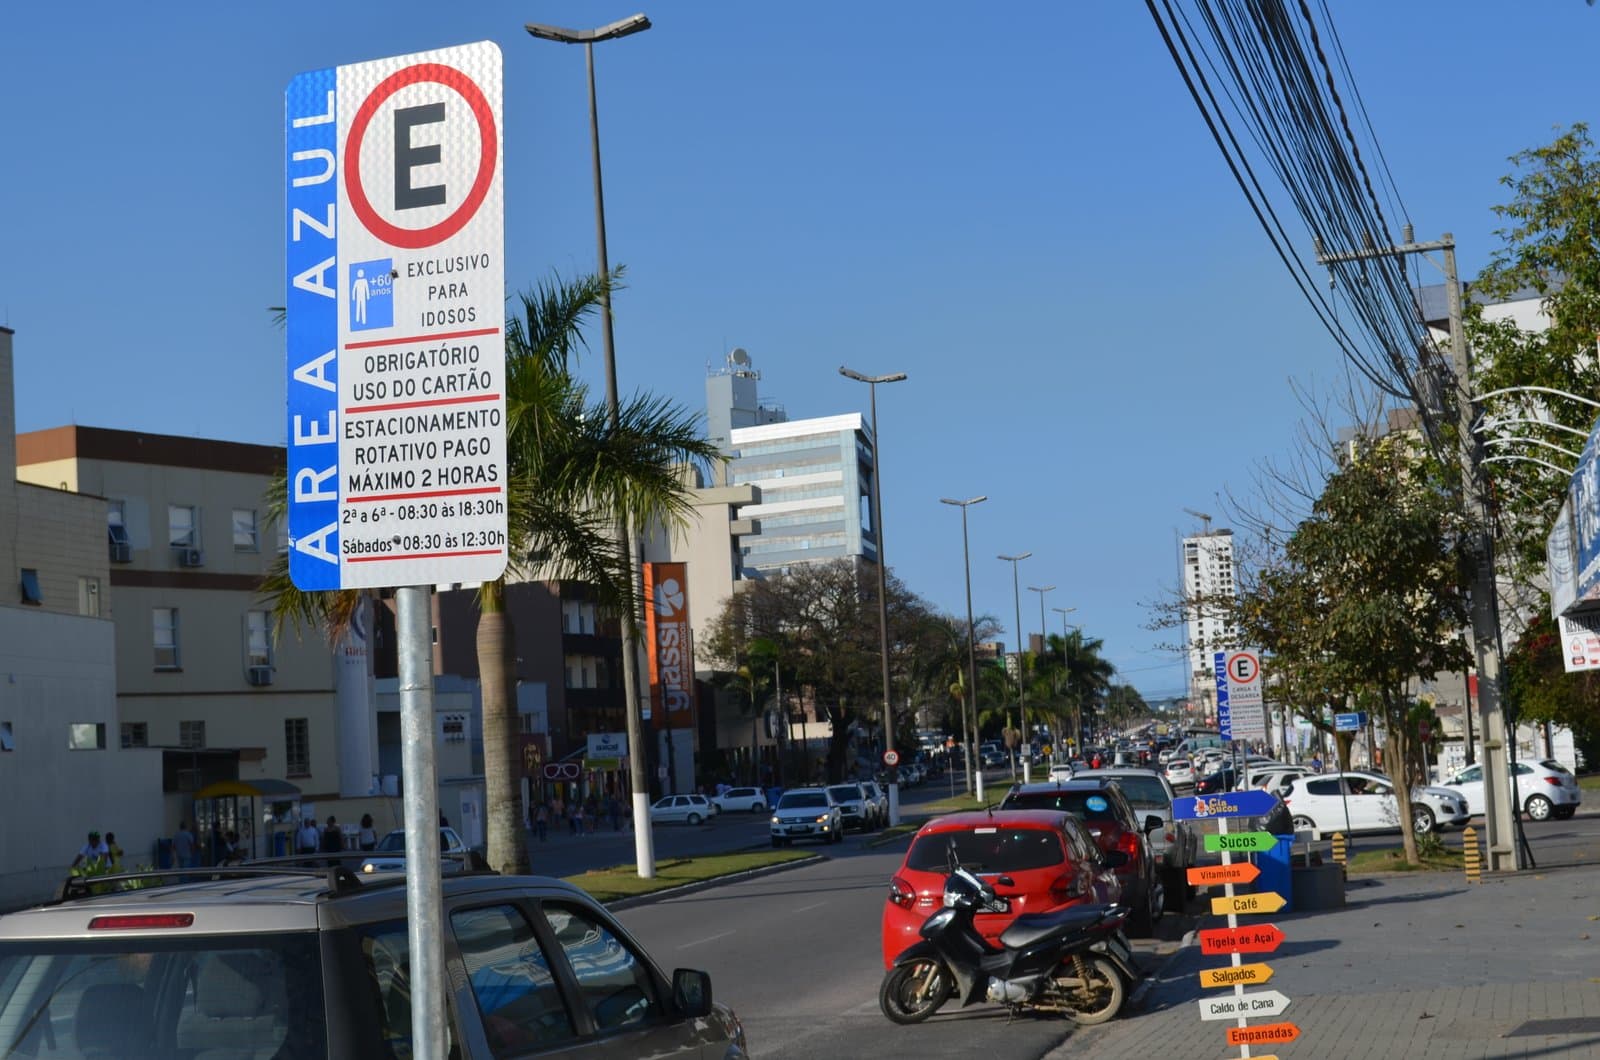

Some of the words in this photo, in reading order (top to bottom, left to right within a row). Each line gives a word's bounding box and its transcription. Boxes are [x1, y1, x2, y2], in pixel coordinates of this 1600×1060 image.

[394, 102, 446, 211] E
[293, 90, 336, 299] AZUL
[407, 253, 490, 277] EXCLUSIVO
[370, 288, 392, 297] anos
[428, 282, 468, 301] PARA
[421, 306, 476, 327] IDOSOS
[364, 342, 480, 374] OBRIGATÓRIO
[353, 381, 387, 401] USO
[393, 378, 416, 397] DO
[422, 368, 492, 395] CARTÃO
[345, 408, 501, 439] ESTACIONAMENTO
[355, 442, 437, 465] ROTATIVO
[443, 437, 491, 458] PAGO
[349, 468, 416, 493] MÁXIMO
[421, 470, 433, 487] 2
[438, 464, 498, 486] HORAS
[360, 512, 368, 523] a
[398, 503, 438, 520] 08:30
[441, 503, 455, 518] às
[458, 500, 504, 517] 18:30h
[342, 538, 393, 554] Sábados
[403, 534, 441, 550] 08:30
[445, 533, 458, 548] às
[461, 530, 505, 547] 12:30h
[1237, 660, 1249, 677] E
[1220, 836, 1257, 849] Sucos
[1200, 869, 1241, 879] Vitaminas
[1233, 897, 1258, 911] Café
[1207, 936, 1236, 949] Tigela
[1239, 935, 1250, 944] de
[1212, 969, 1256, 984] Salgados
[1210, 1003, 1235, 1014] Caldo
[1238, 1001, 1249, 1011] de
[1251, 999, 1274, 1010] Cana
[1231, 1027, 1293, 1042] Empanadas
